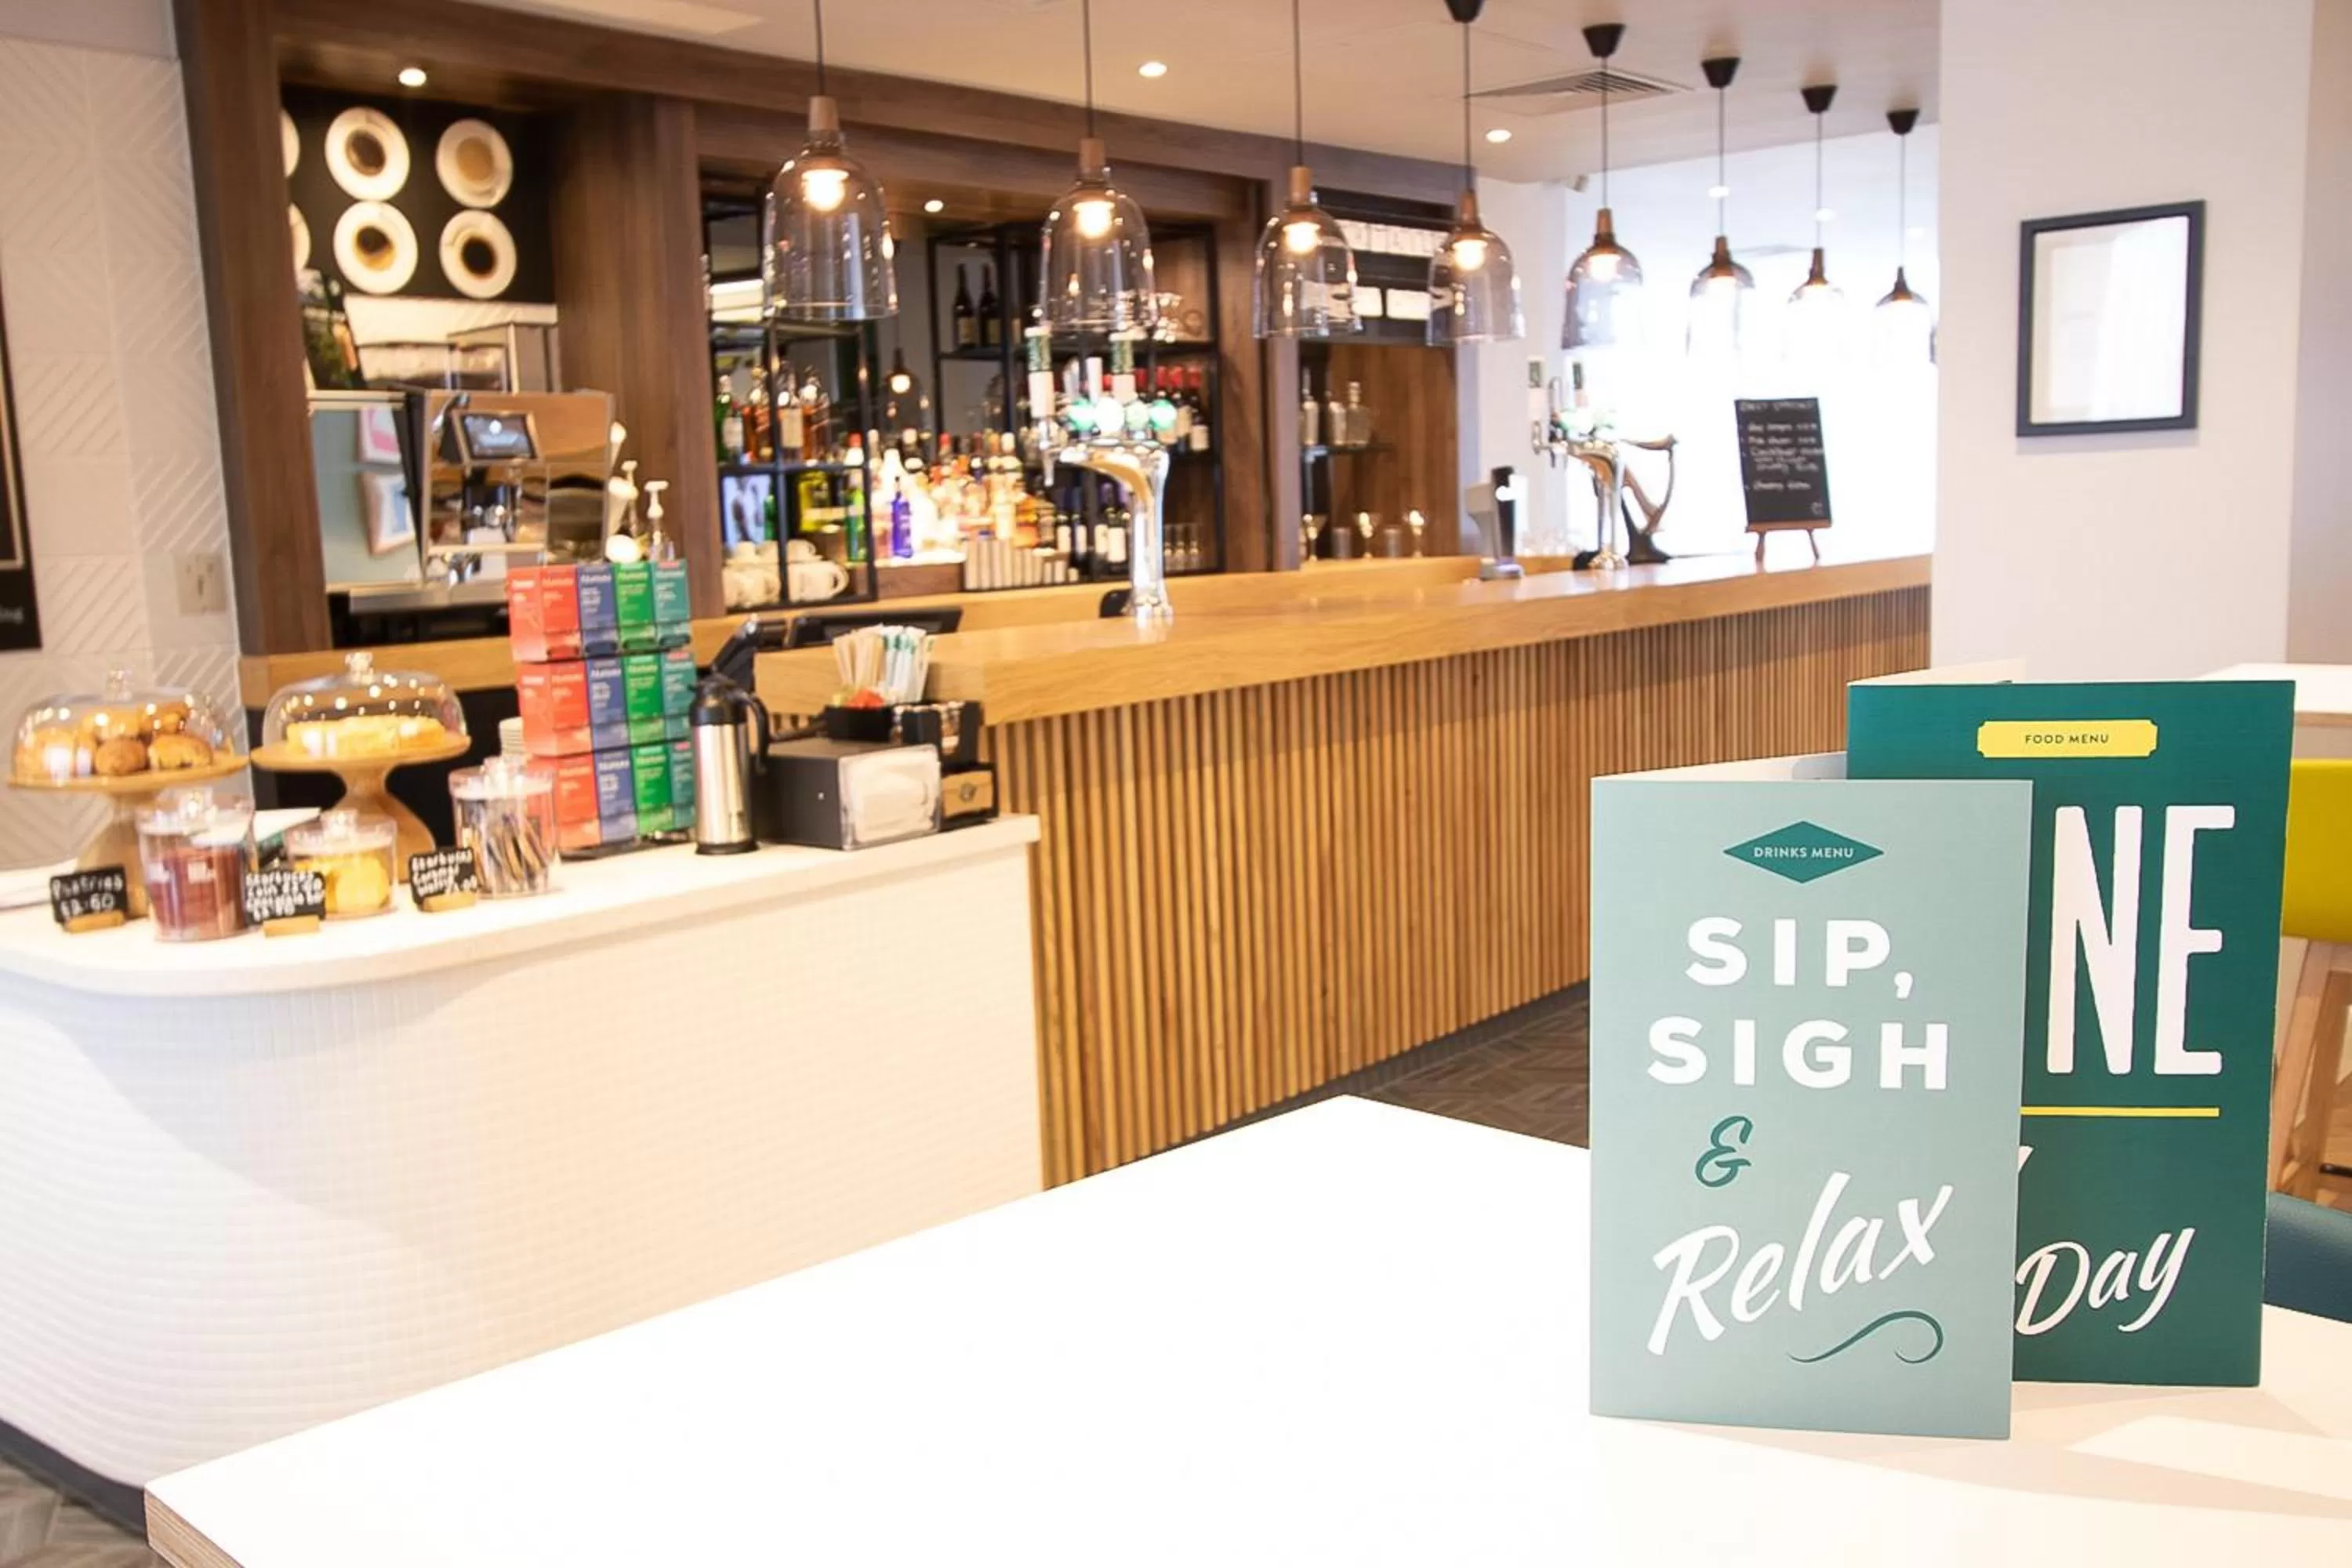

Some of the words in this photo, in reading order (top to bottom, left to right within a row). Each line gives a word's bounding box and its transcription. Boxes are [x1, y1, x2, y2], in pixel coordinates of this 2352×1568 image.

[2025, 735, 2064, 744] FOOD
[2069, 734, 2110, 744] MENU
[1753, 846, 1807, 858] DRINKS
[1811, 847, 1854, 858] MENU
[1685, 916, 1913, 999] SIP,
[2047, 805, 2235, 1075] NE
[1646, 1015, 1948, 1090] SIGH
[1694, 1115, 1753, 1189] &
[1646, 1171, 1953, 1356] Relax
[2014, 1227, 2195, 1335] Day
